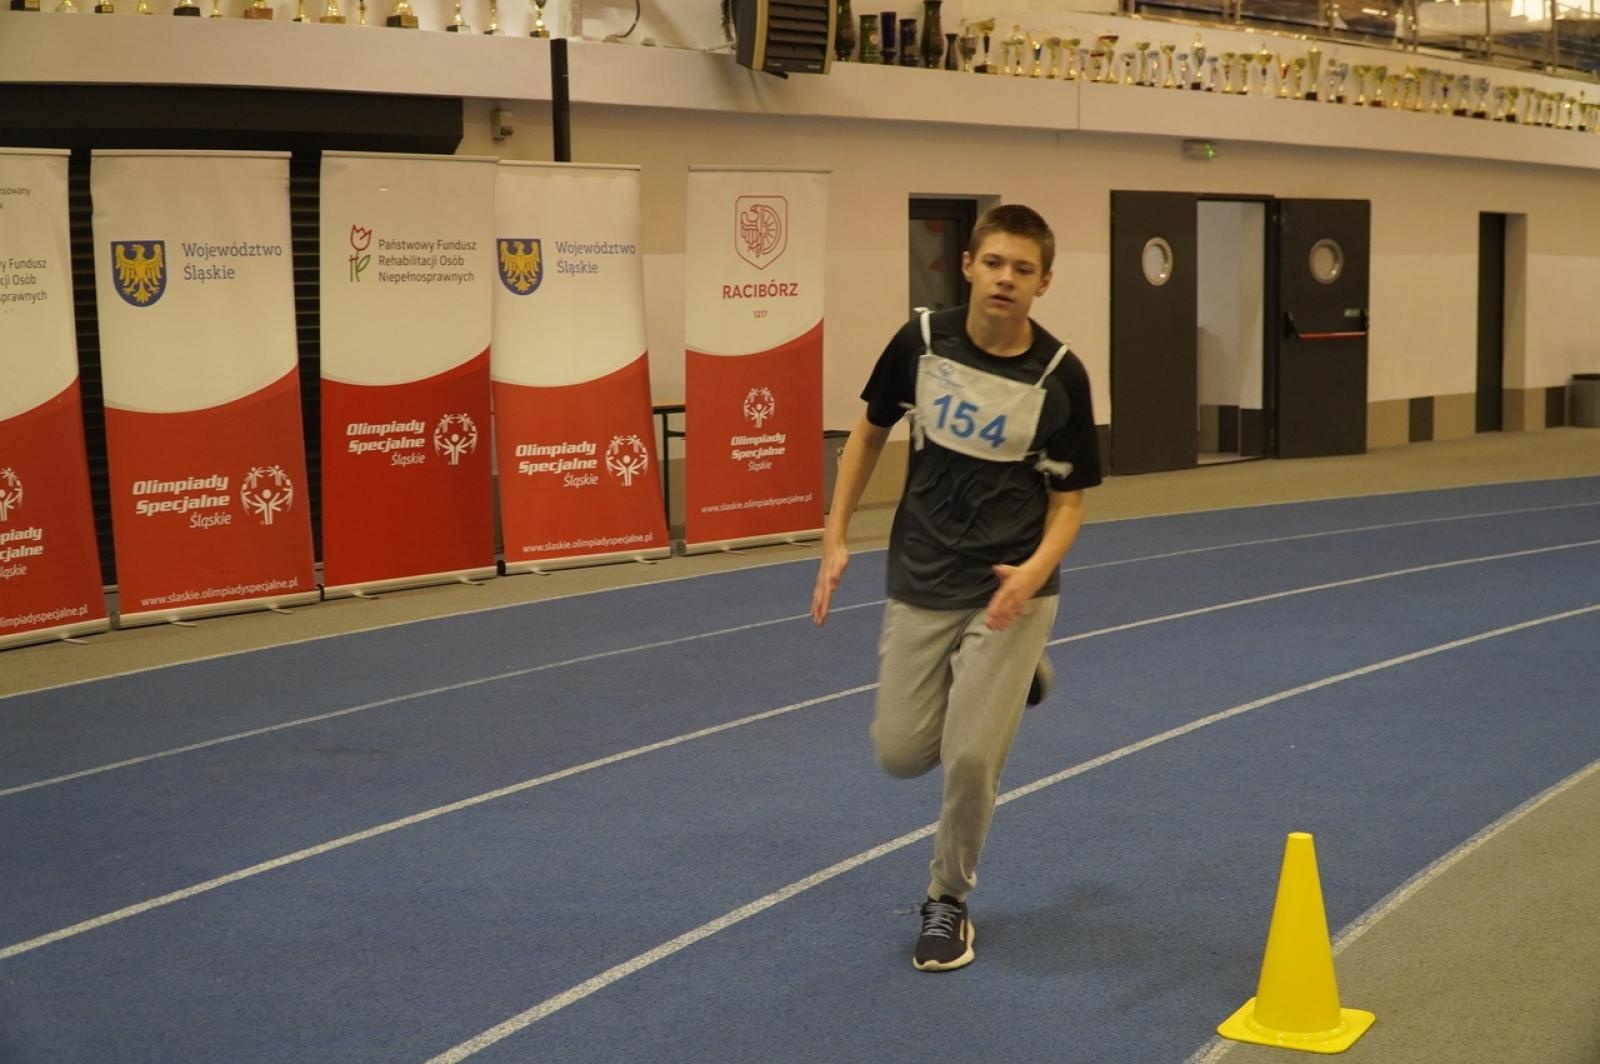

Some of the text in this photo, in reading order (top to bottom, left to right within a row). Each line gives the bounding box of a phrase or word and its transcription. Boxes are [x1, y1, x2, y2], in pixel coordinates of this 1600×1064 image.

[181, 242, 282, 260] Województwo
[378, 239, 477, 253] Państwowy Fundusz
[554, 241, 637, 257] Województwo
[9, 257, 48, 269] Fundusz
[378, 254, 465, 269] Rehabilitacji Osób
[557, 259, 599, 277] Śląskie
[12, 272, 37, 286] Osób
[183, 263, 236, 284] Śląskie
[378, 271, 475, 285] Niepełnosprawnych
[0, 289, 48, 305] prawnych
[722, 279, 799, 300] RACIBÓRZ
[346, 419, 426, 436] Olimpiady
[934, 394, 1008, 449] 154
[348, 436, 426, 455] Specjalne
[730, 433, 786, 446] Olimpiady
[515, 441, 597, 458] Olimpiady
[731, 446, 786, 461] Specjalne
[390, 452, 426, 467] Śląskie
[518, 458, 598, 476] Specjalne
[132, 474, 230, 496] Olimpiady
[563, 472, 599, 489] Śląskie
[135, 494, 231, 517] Specjalne
[190, 512, 232, 530] Śląskie
[0, 526, 43, 546] piady
[522, 532, 654, 553] www.slaskie.olimpiadyspecjalne.pl
[0, 563, 28, 580] ląskie
[140, 576, 298, 607] www.slaskie.olimpiadyspecjalne.pl
[0, 603, 88, 628] limpiadyspecjalne.pl
